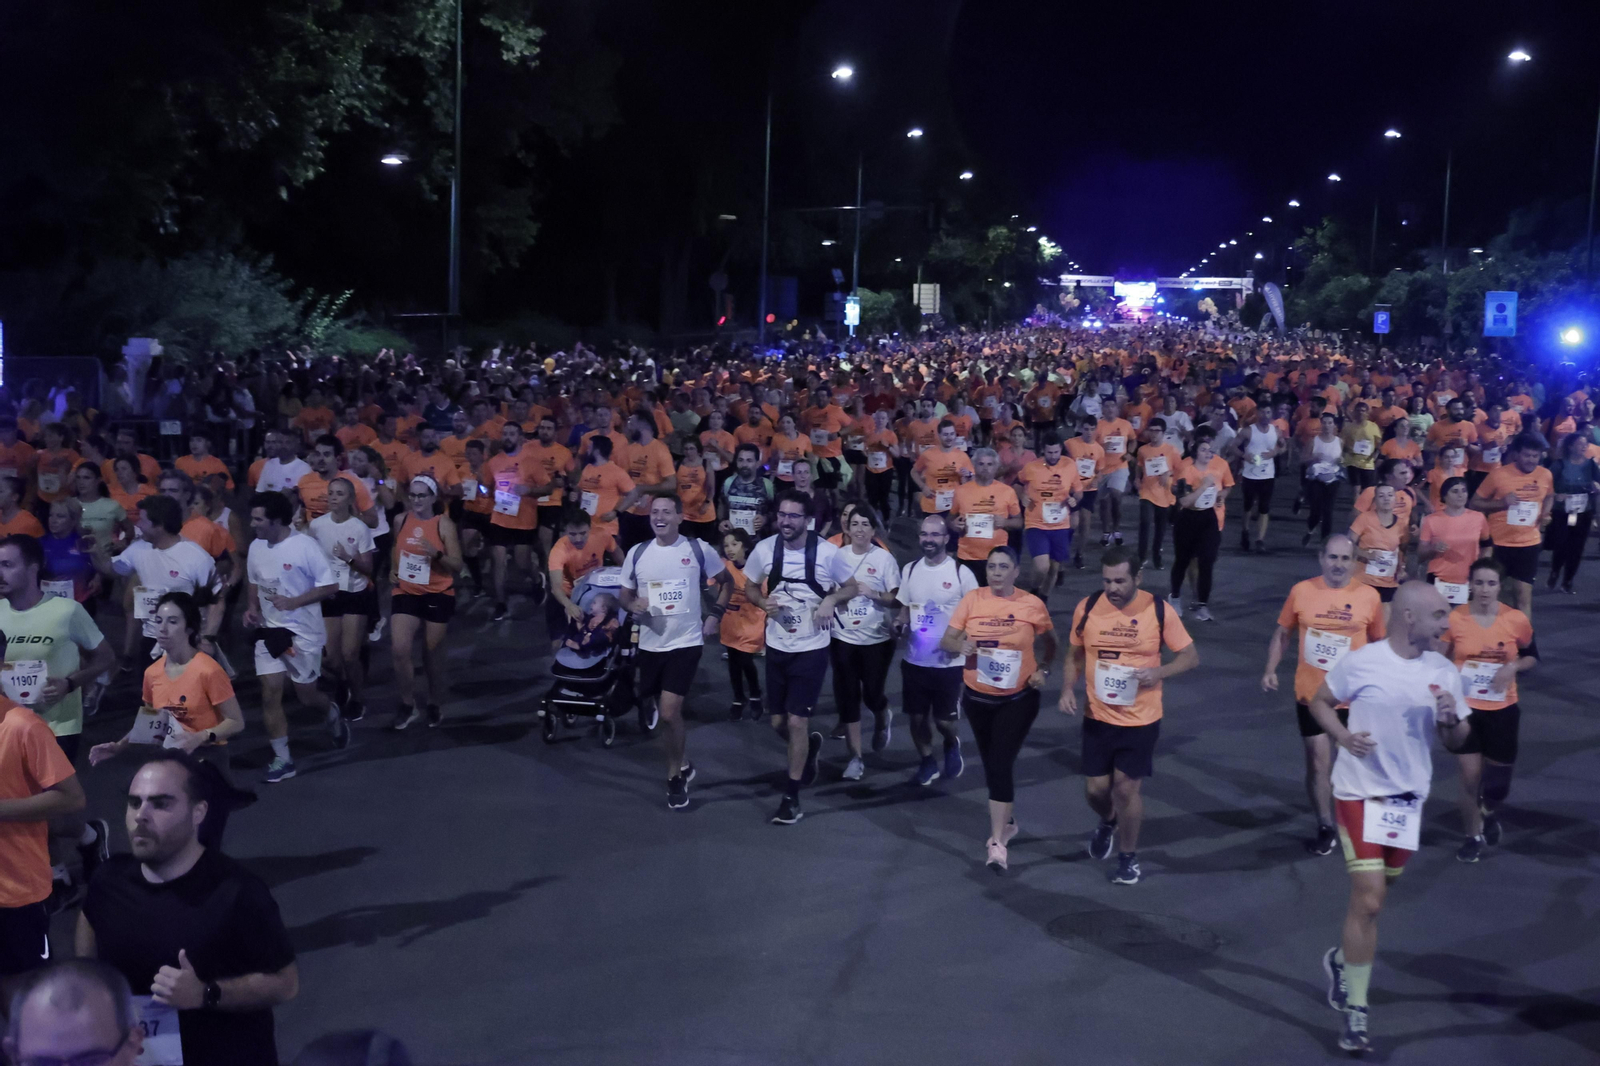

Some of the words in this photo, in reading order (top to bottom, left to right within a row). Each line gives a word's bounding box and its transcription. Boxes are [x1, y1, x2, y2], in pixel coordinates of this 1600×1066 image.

[1377, 314, 1387, 324] P
[658, 591, 683, 601] 10328
[846, 607, 867, 617] 11462
[783, 615, 802, 625] 9053
[1315, 643, 1337, 657] 5363
[989, 661, 1011, 673] 6396
[11, 675, 38, 687] 11907
[1104, 677, 1127, 690] 6395
